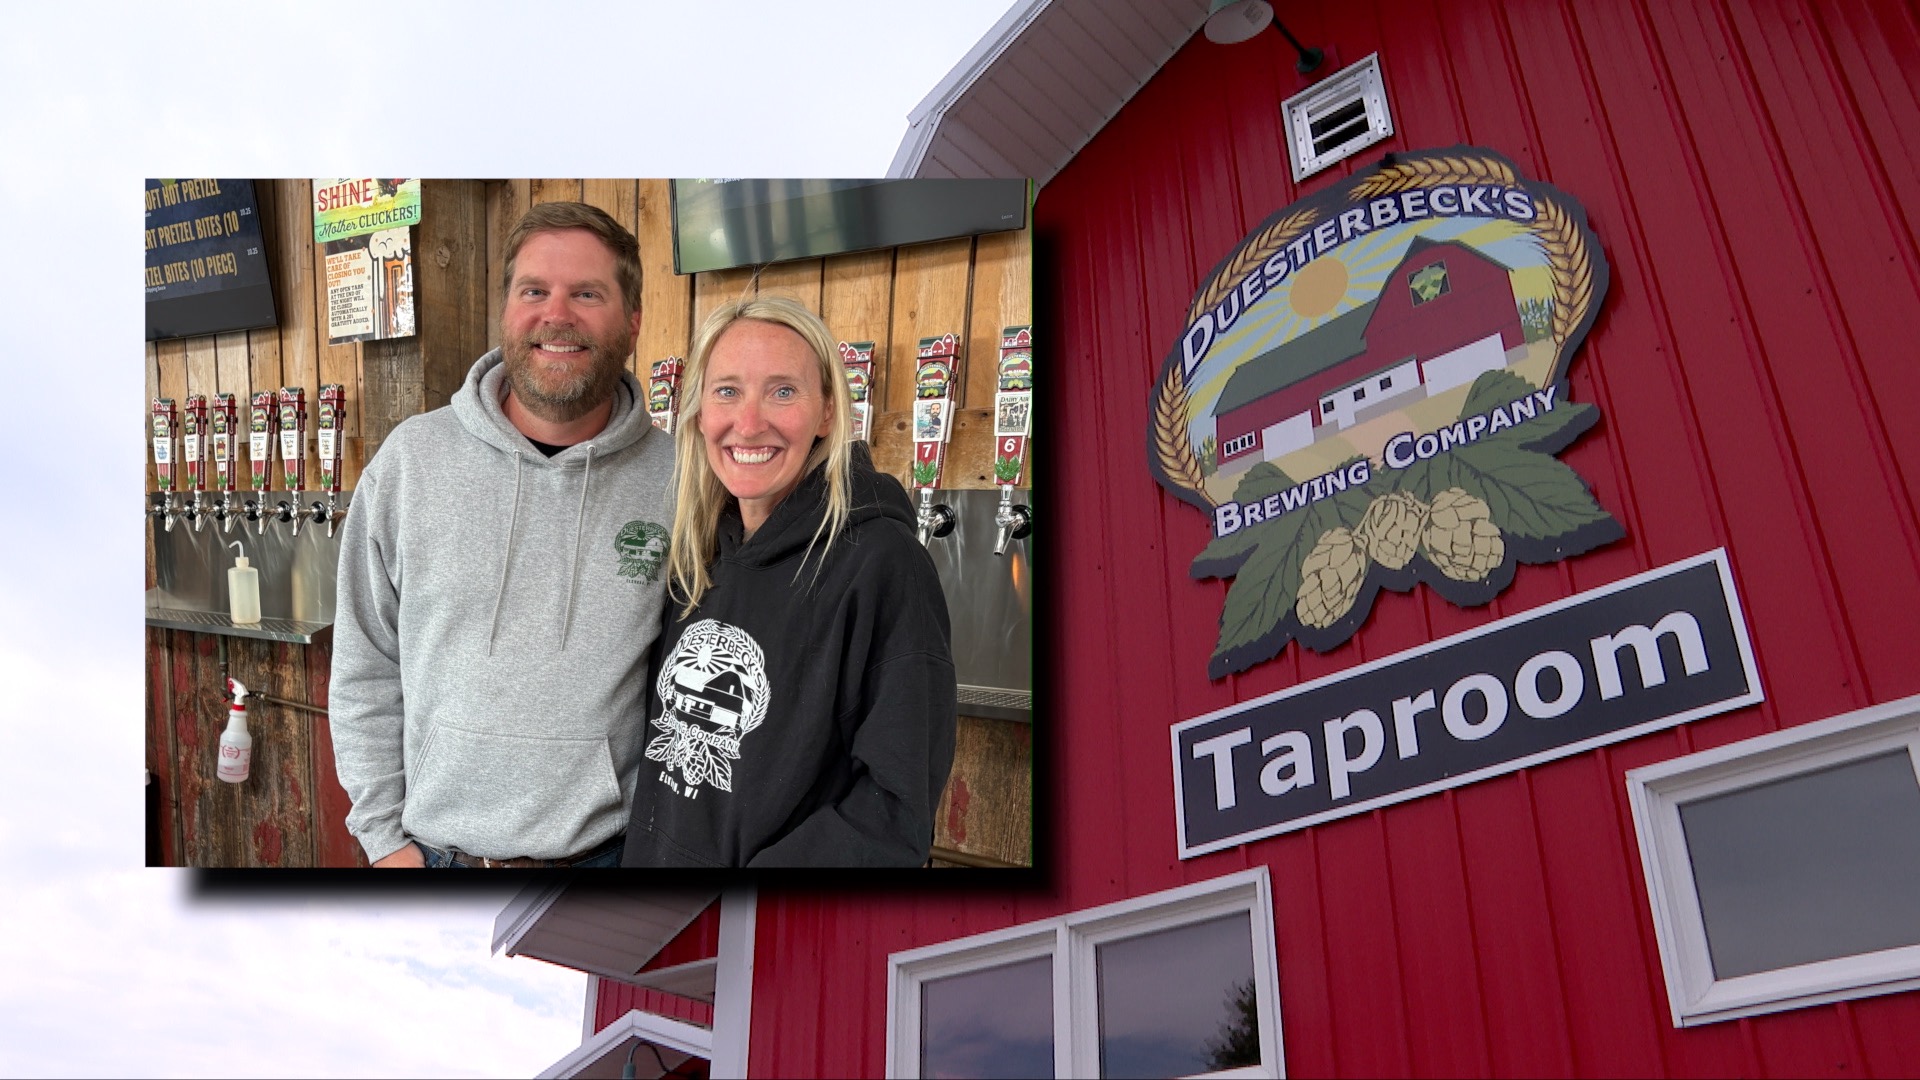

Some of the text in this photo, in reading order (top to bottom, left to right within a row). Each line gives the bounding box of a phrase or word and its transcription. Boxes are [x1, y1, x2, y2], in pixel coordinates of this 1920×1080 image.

[162, 184, 181, 207] HOT
[181, 179, 221, 202] PRETZEL
[318, 178, 372, 212] SHINE
[158, 221, 195, 247] PRETZEL
[195, 214, 222, 240] BITES
[223, 210, 240, 238] (10
[319, 204, 418, 238] Mother CLUCKERS!
[145, 252, 238, 288] TZEL BITES (10 PIECE)
[327, 252, 361, 265] WE'LL TAKE
[328, 264, 342, 272] CARE
[328, 267, 365, 280] CLOSING YOU
[328, 279, 341, 288] OUT!
[1179, 185, 1536, 377] DUESTERBECK'S
[331, 306, 368, 316] AUTOMATICALLY
[922, 444, 932, 458] 7
[1004, 438, 1016, 452] 6
[1214, 386, 1556, 537] BREWING COMPANY
[1192, 610, 1710, 812] Taproom
[690, 724, 740, 751] COMPANY
[684, 786, 698, 800] WI
